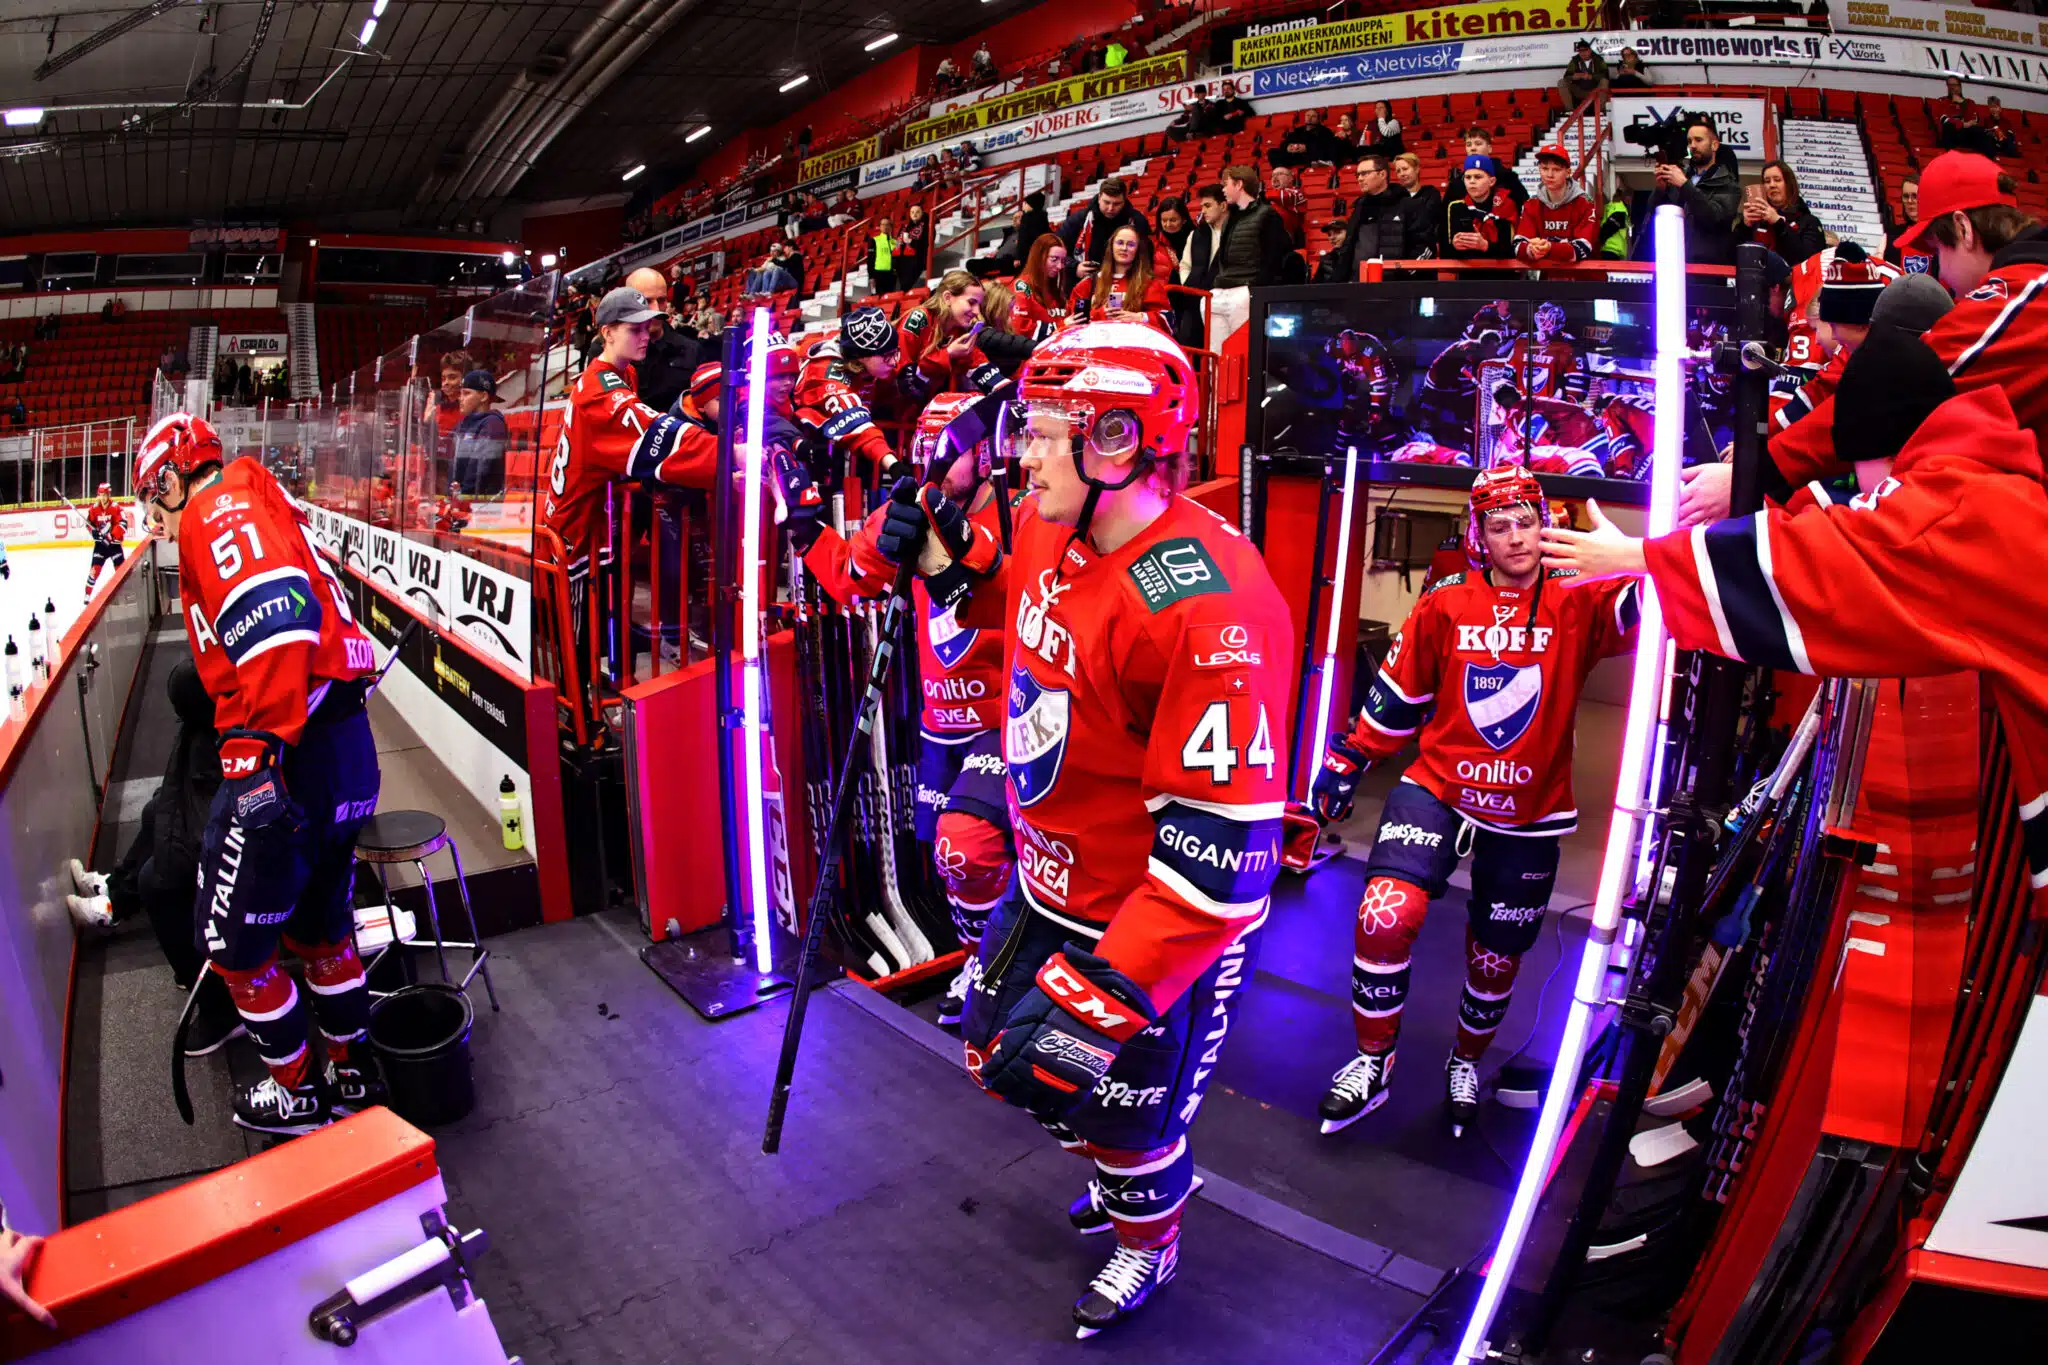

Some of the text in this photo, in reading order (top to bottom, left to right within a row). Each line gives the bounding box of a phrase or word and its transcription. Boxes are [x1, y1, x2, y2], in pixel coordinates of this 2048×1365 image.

[1240, 32, 1301, 51] RAKENTAJAN
[1303, 19, 1384, 40] VERKKOKAUPPA
[1405, 0, 1597, 41] kitema.fi
[1240, 31, 1393, 66] KAIKKI RAKENTAMISEEN!
[1375, 48, 1451, 72] Netvisor
[1636, 36, 1821, 59] extremeworks.fi
[1082, 59, 1185, 100] KITEMA
[1158, 73, 1252, 111] SJÖEG
[1276, 65, 1347, 86] Netvisor
[987, 86, 1072, 124] KITEMA
[1023, 105, 1100, 140] SJÖBERG
[907, 112, 979, 147] KITEMA
[1717, 127, 1749, 143] rks
[800, 138, 877, 183] kitema.fi
[331, 517, 343, 539] VRJ
[349, 523, 364, 550] VRJ
[210, 523, 264, 581] 51
[374, 534, 396, 565] VRJ
[1067, 548, 1087, 567] CCM
[1160, 544, 1211, 586] UB
[408, 549, 442, 590] VRJ
[1142, 560, 1168, 593] UNITED
[461, 566, 515, 626] VRJ
[190, 603, 218, 652] A
[223, 597, 289, 647] GIGANTTI
[1456, 625, 1553, 652] KOFF
[1473, 676, 1504, 691] 1897
[933, 706, 981, 723] SVEA
[1180, 700, 1275, 786] 44
[222, 755, 257, 772] CM
[1456, 759, 1533, 785] onitio
[1460, 788, 1516, 811] SVEA
[1158, 824, 1269, 873] GIGANTTI
[1022, 843, 1069, 897] SVEA
[1043, 964, 1129, 1028] CM
